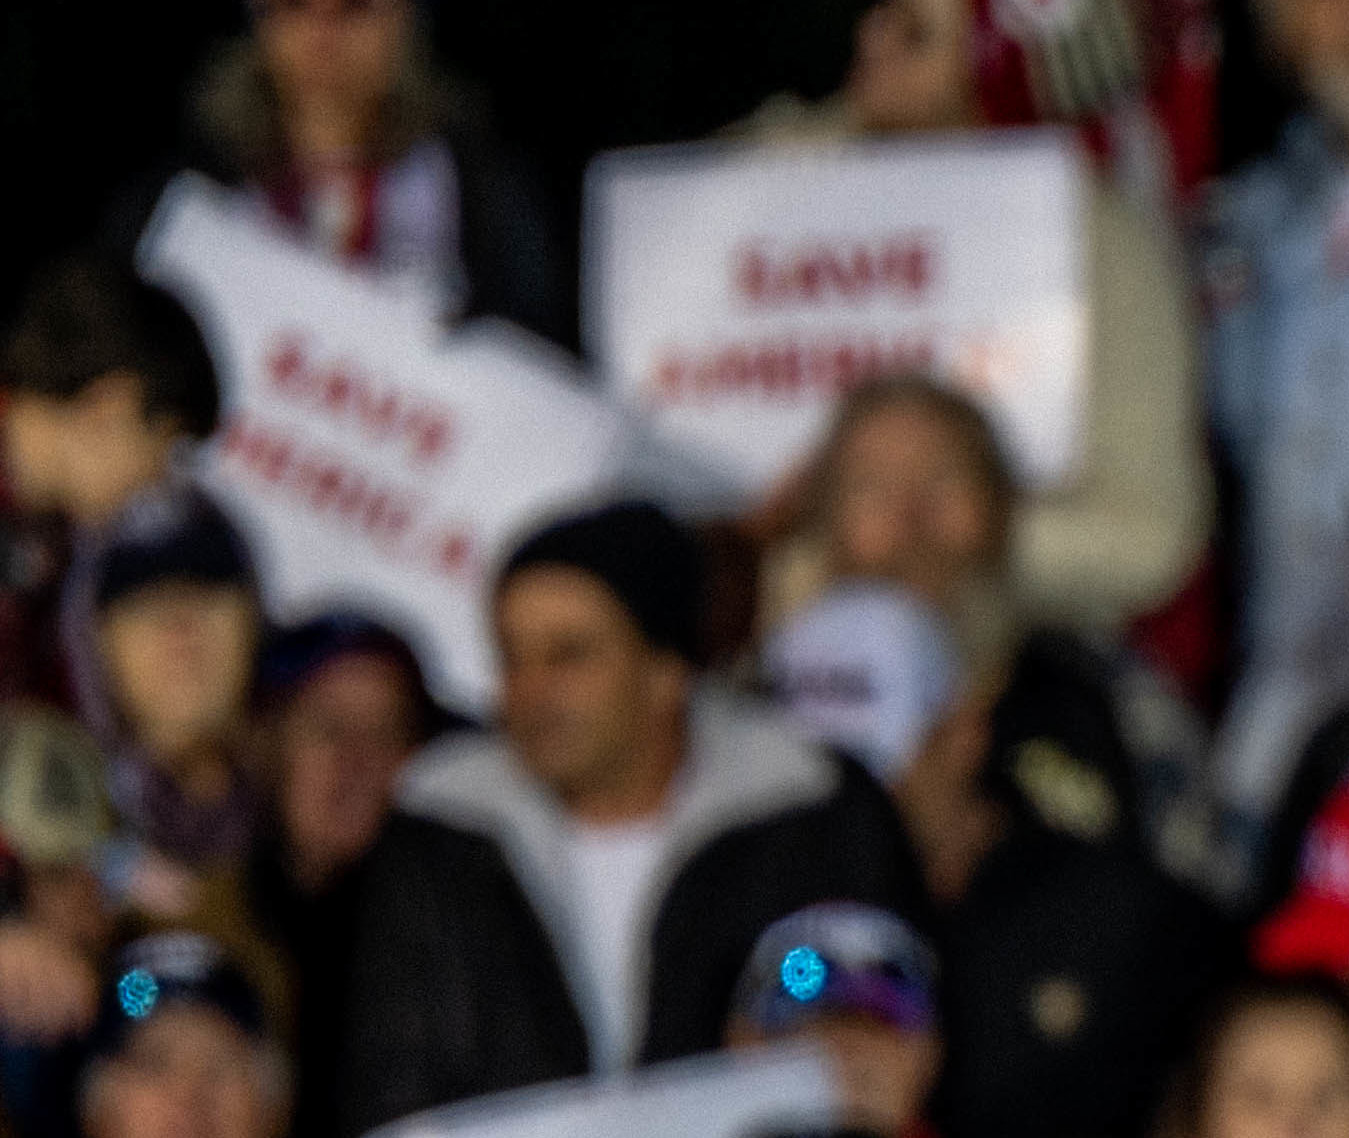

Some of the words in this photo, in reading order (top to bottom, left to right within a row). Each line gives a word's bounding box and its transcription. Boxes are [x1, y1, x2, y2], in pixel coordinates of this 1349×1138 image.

[732, 230, 942, 308] SAVE
[262, 330, 456, 466] SAVE
[218, 412, 480, 578] MERICA
